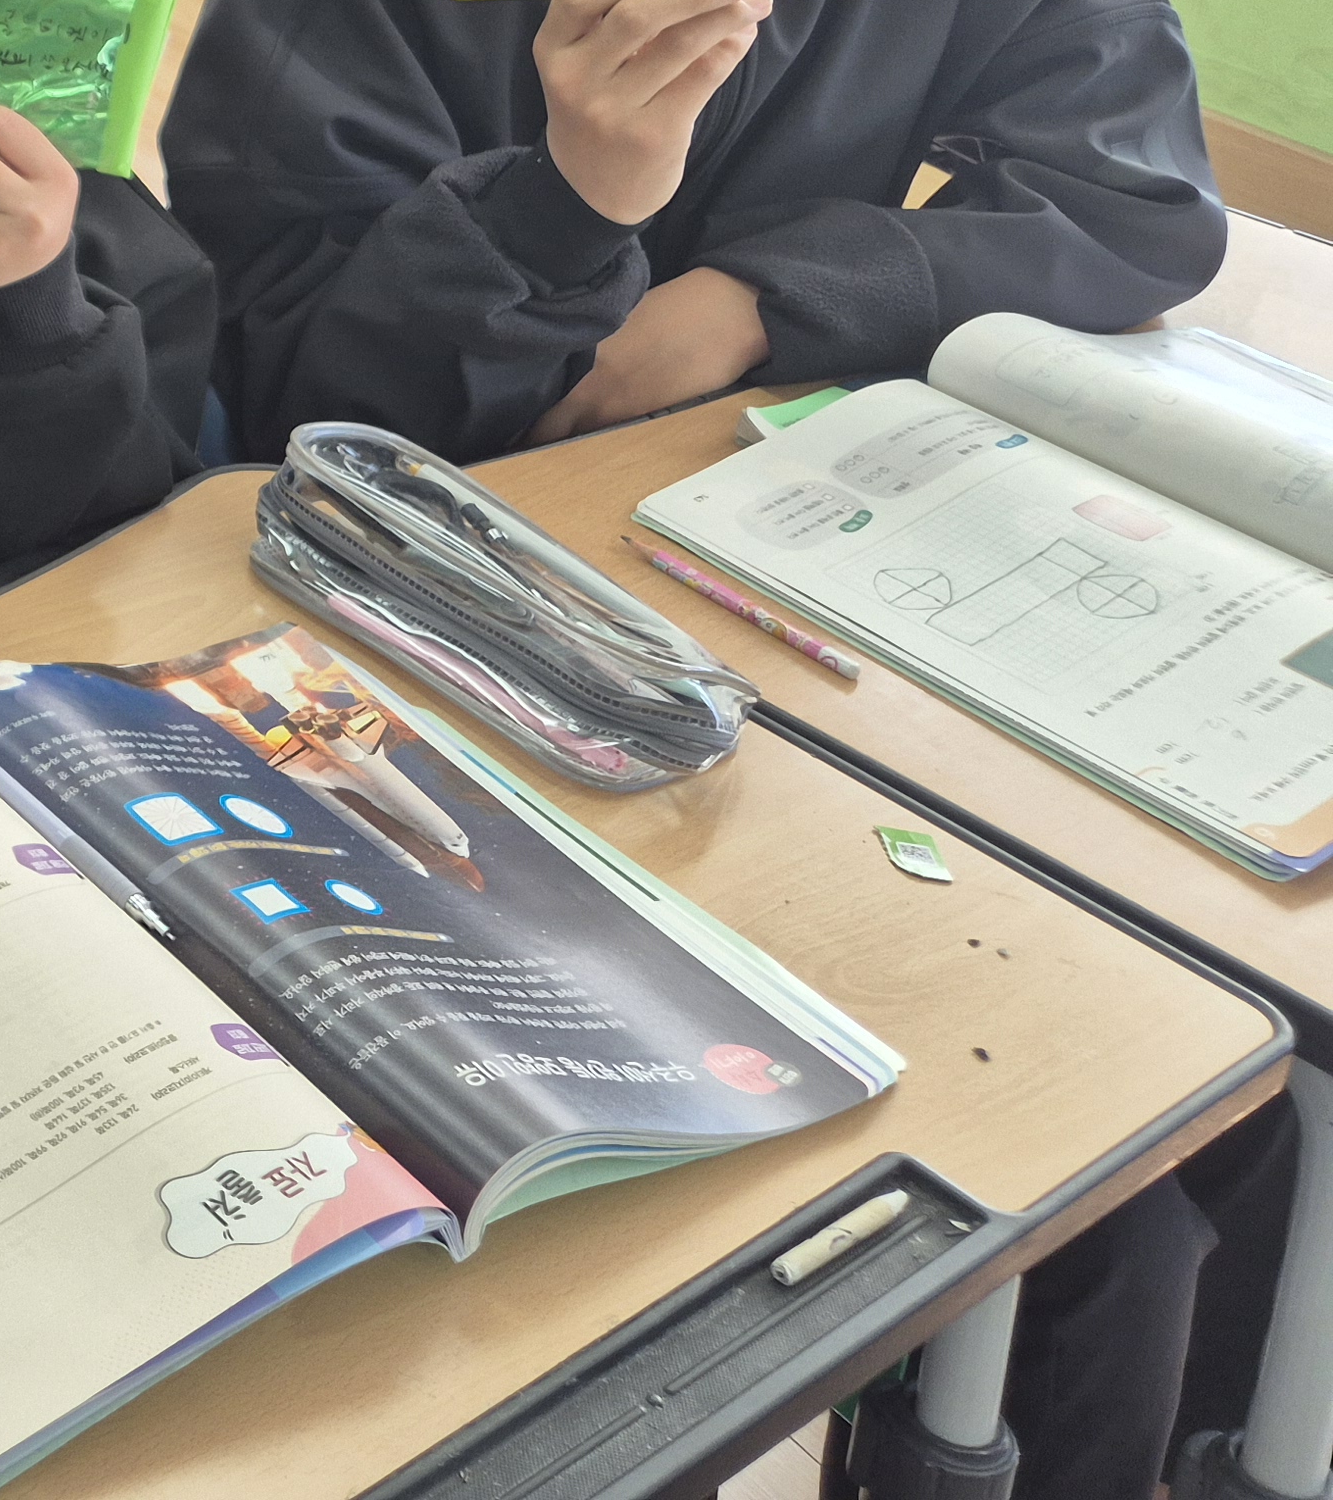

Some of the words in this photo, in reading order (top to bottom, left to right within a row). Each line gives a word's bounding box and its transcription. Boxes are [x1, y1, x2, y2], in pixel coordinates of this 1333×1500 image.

[295, 1001, 316, 1022] 커지
[332, 995, 365, 1018] 거리가
[313, 1016, 333, 1036] 서로
[453, 1059, 505, 1086] 이유
[94, 1118, 118, 1135] 133쪽
[261, 1151, 327, 1198] 자료
[202, 1170, 263, 1233] 출처
